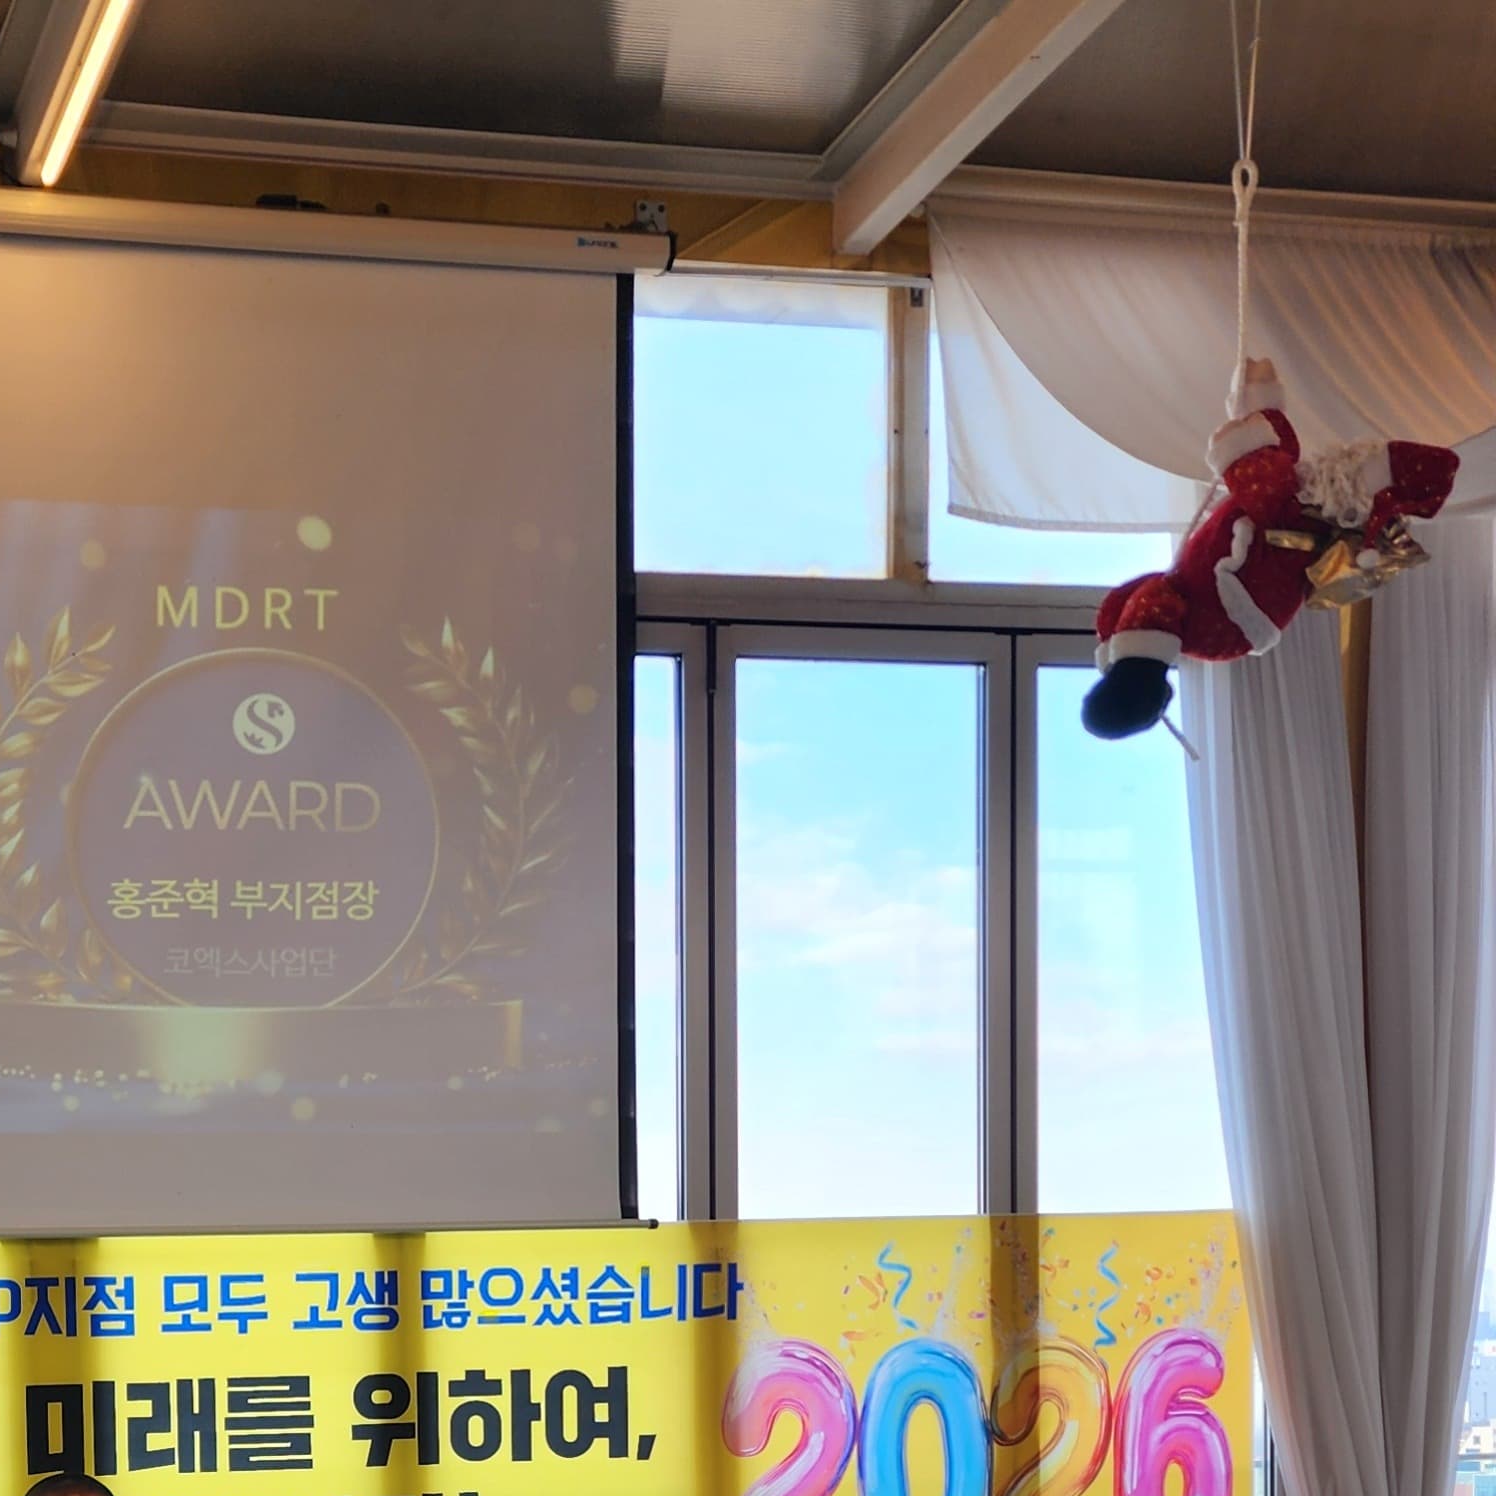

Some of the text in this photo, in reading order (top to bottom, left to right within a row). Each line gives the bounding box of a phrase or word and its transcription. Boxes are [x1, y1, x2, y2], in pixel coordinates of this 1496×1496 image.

[155, 584, 339, 631] MDRT
[122, 778, 381, 833] AWARD
[107, 878, 378, 920] 홍준혁 부지점장
[163, 946, 337, 978] 코엑스사업단
[160, 1273, 269, 1335] 모두
[292, 1271, 398, 1332] 고생
[421, 1261, 745, 1330] 많으셨습니다
[25, 1375, 315, 1476] 미래를
[351, 1365, 657, 1467] 위하여,
